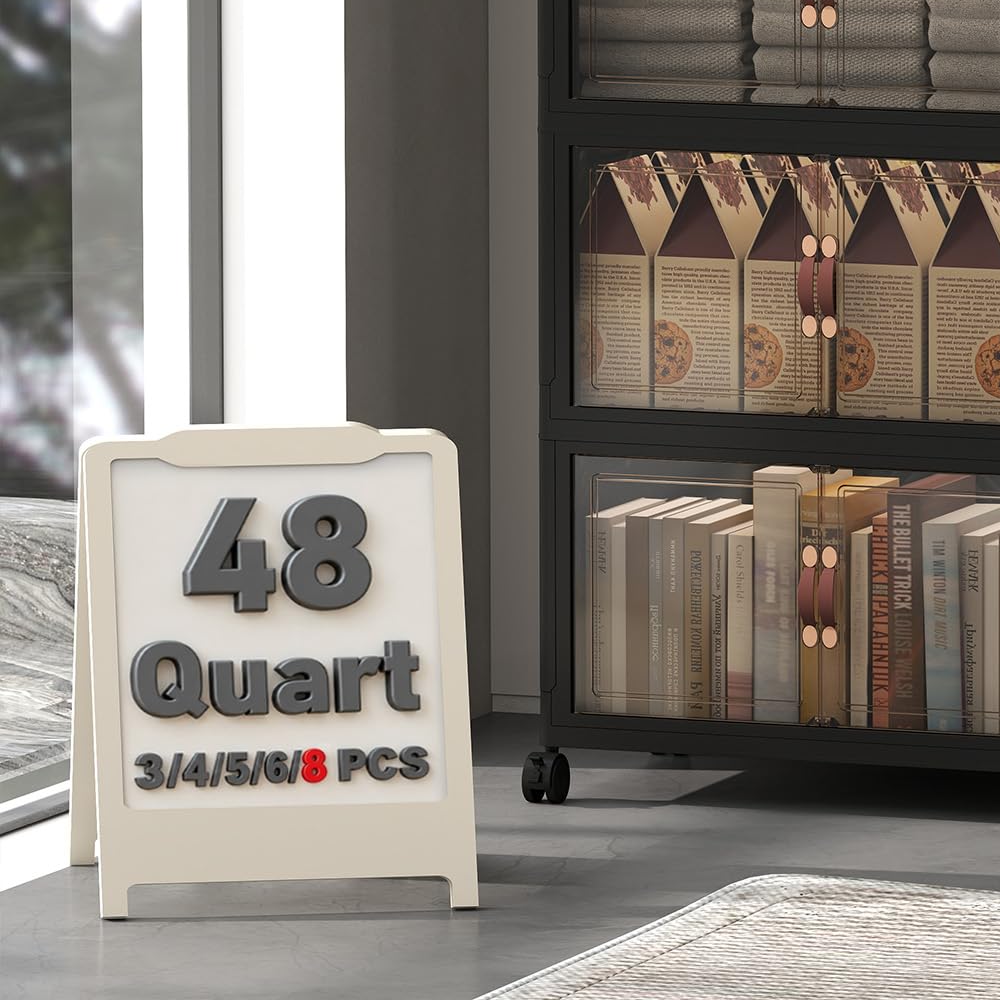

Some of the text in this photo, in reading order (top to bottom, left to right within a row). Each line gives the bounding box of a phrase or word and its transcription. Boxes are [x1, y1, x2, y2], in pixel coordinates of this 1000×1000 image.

[181, 493, 372, 613] 48
[736, 545, 745, 603] Carol Shields
[932, 540, 947, 649] TIM WINTON DIRT MUSIC
[892, 504, 912, 698] THE BULLET TRICK LOUISE WELSH
[131, 640, 422, 720] Quart
[134, 745, 430, 790] 3/4/5/6/8 PCS
